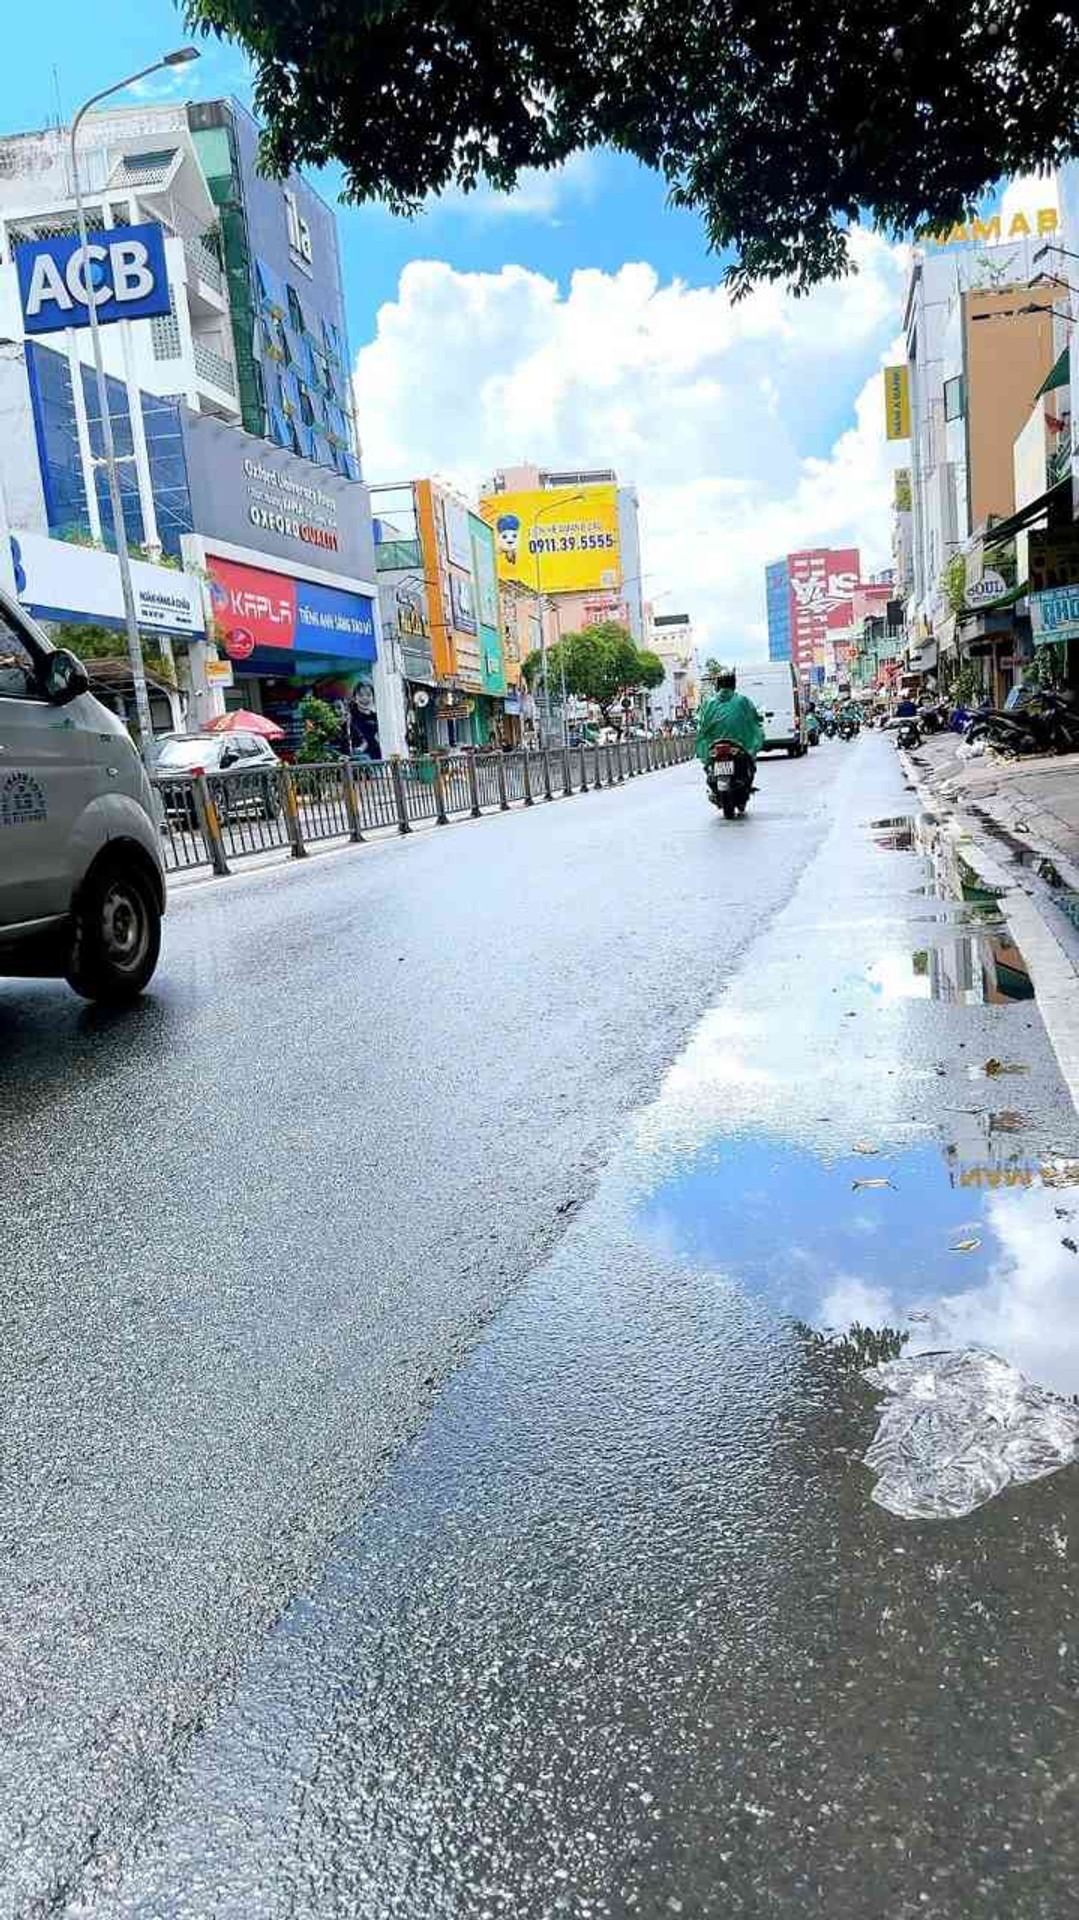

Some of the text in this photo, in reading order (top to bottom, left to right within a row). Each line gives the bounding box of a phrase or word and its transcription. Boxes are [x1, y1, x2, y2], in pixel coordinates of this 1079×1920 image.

[26, 240, 154, 314] ACB
[249, 505, 300, 538] OXFORD
[529, 534, 614, 554] 0911.39.5555
[967, 581, 1003, 596] SOUL
[231, 588, 292, 625] KAPLA
